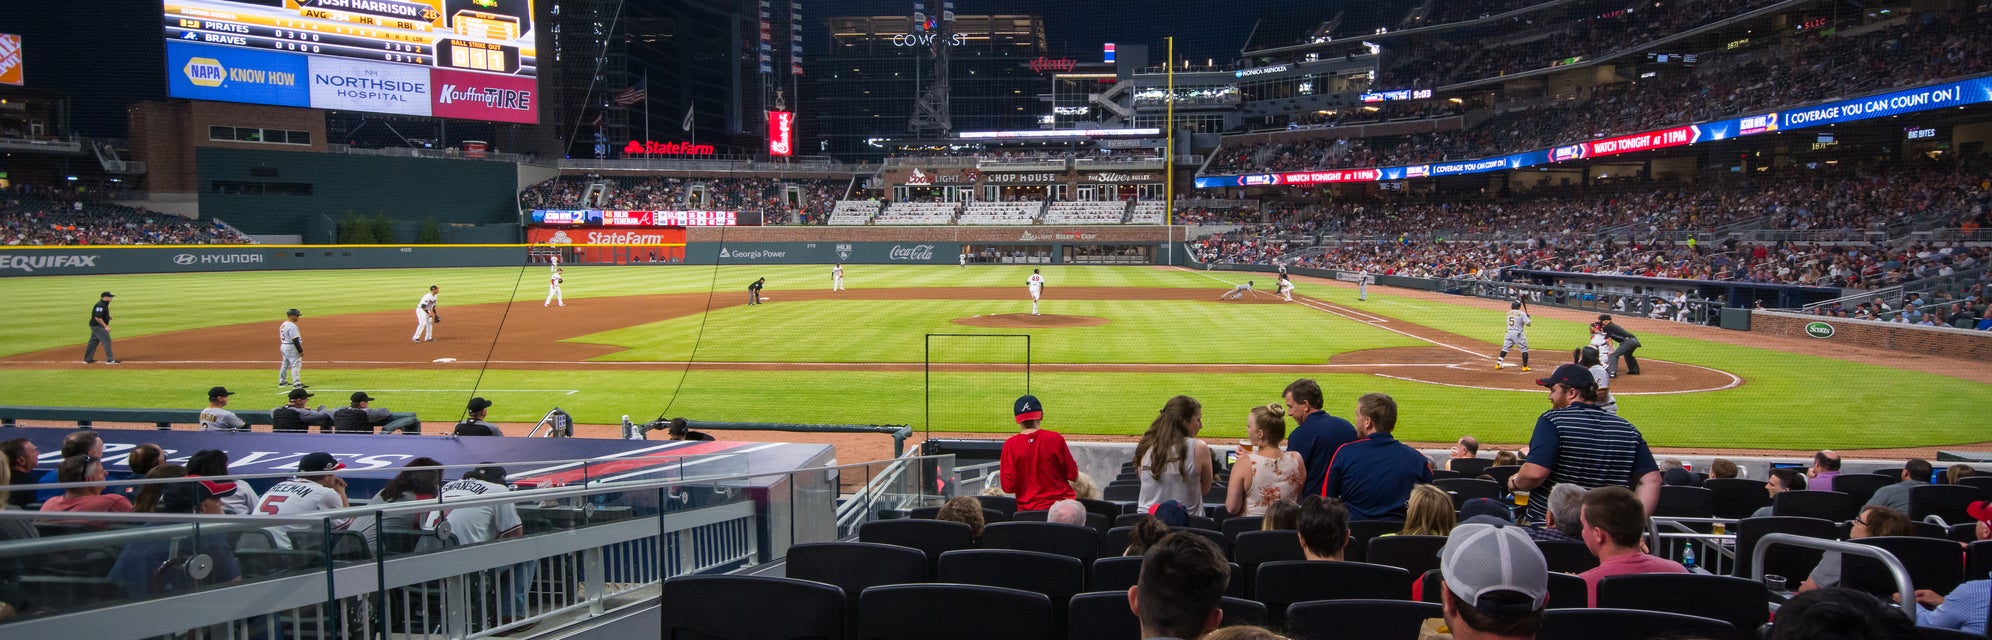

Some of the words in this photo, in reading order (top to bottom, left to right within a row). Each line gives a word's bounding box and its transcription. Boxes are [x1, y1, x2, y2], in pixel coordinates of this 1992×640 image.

[306, 9, 326, 19] AVG
[352, 0, 417, 17] HARRISON
[359, 16, 374, 25] HR
[397, 21, 413, 30] RBI
[205, 21, 249, 34] PIRATES
[275, 29, 282, 37] 0
[288, 30, 294, 39] 3
[300, 31, 307, 40] 0
[312, 33, 319, 42] 0
[385, 42, 391, 50] 3
[395, 43, 401, 51] 3
[405, 44, 412, 52] 0
[415, 45, 421, 53] 2
[205, 33, 247, 45] BRAVES
[275, 41, 282, 49] 0
[288, 42, 295, 51] 0
[300, 43, 307, 52] 0
[312, 45, 320, 53] 0
[385, 53, 392, 61] 0
[190, 64, 221, 80] NAPA
[229, 67, 265, 84] KNOW
[268, 71, 295, 87] HOW
[1242, 69, 1263, 77] KONICA
[315, 74, 426, 94] NORTHSIDE
[337, 89, 408, 102] HOSPITAL
[439, 83, 498, 104] Kauffman
[484, 87, 531, 110] TIRE
[1413, 89, 1432, 99] 9:03
[1791, 107, 1839, 125] COVERAGE
[1841, 103, 1863, 117] YOU
[1865, 99, 1888, 113] CAN
[1890, 93, 1929, 109] COUNT
[1932, 88, 1951, 101] ON
[1918, 129, 1936, 138] BITES
[1593, 142, 1617, 154] WATCH
[1617, 135, 1651, 151] TONIGHT
[1652, 136, 1662, 146] AT
[1663, 129, 1687, 144] 11PM
[1436, 165, 1464, 173] COVERAGE
[1464, 163, 1476, 171] YOU
[1485, 161, 1498, 169] COUNT
[1497, 160, 1504, 168] ON
[935, 175, 960, 183] LIGHT
[988, 173, 1017, 183] CHOP
[1020, 173, 1056, 182] HOUSE
[1286, 173, 1310, 182] WATCH
[1311, 172, 1342, 182] TONIGHT
[1353, 170, 1374, 180] 11PM
[573, 210, 585, 225] 2
[587, 231, 661, 246] StateFarm
[201, 253, 263, 264] HYUNDAI
[731, 249, 762, 260] Georgia
[763, 249, 786, 258] Power
[0, 254, 97, 272] EQUIFAX
[1508, 316, 1515, 327] 5
[260, 495, 290, 516] 5
